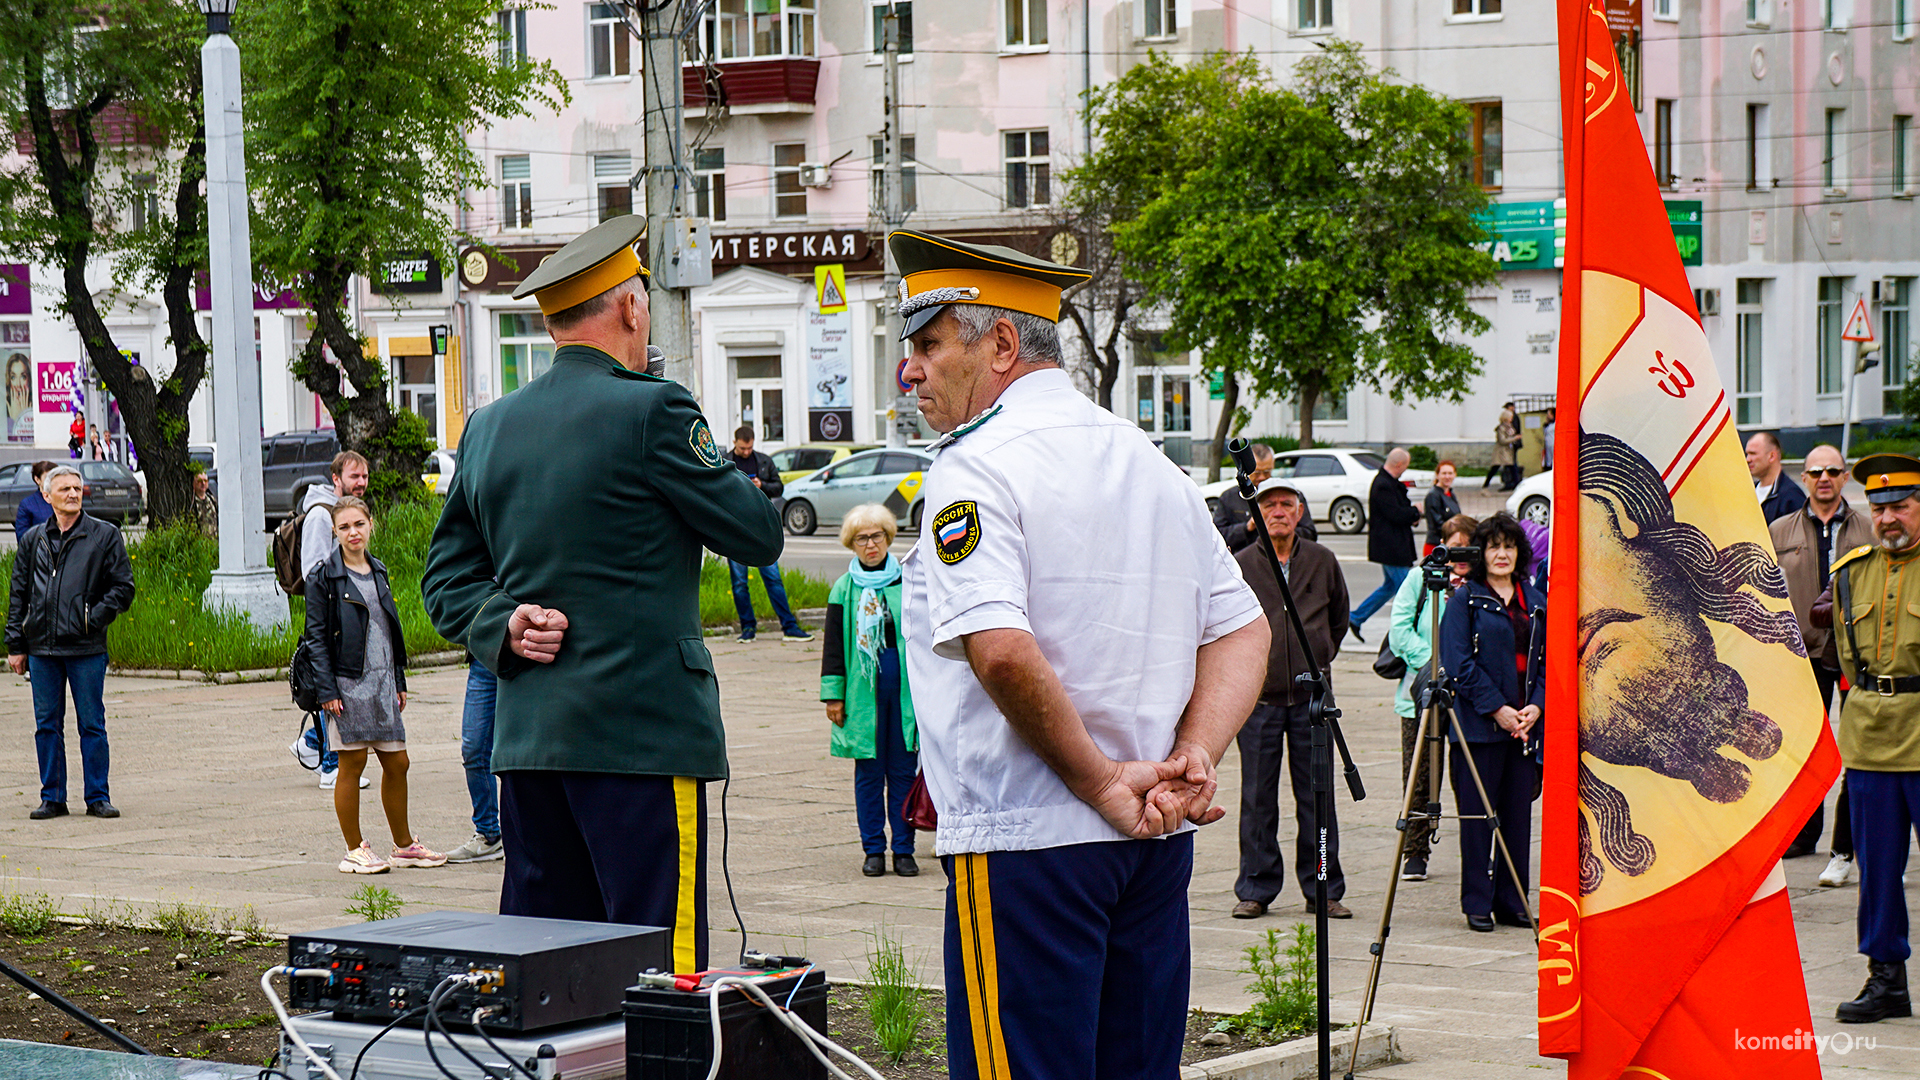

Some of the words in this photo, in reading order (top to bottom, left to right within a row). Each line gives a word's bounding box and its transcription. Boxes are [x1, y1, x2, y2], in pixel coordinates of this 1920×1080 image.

[390, 260, 428, 272] COFFEE
[390, 271, 413, 283] LIKE
[42, 370, 72, 390] 1.06
[41, 393, 71, 403] открыти
[933, 504, 973, 530] РОССИЯ
[1317, 826, 1328, 882] Soundking
